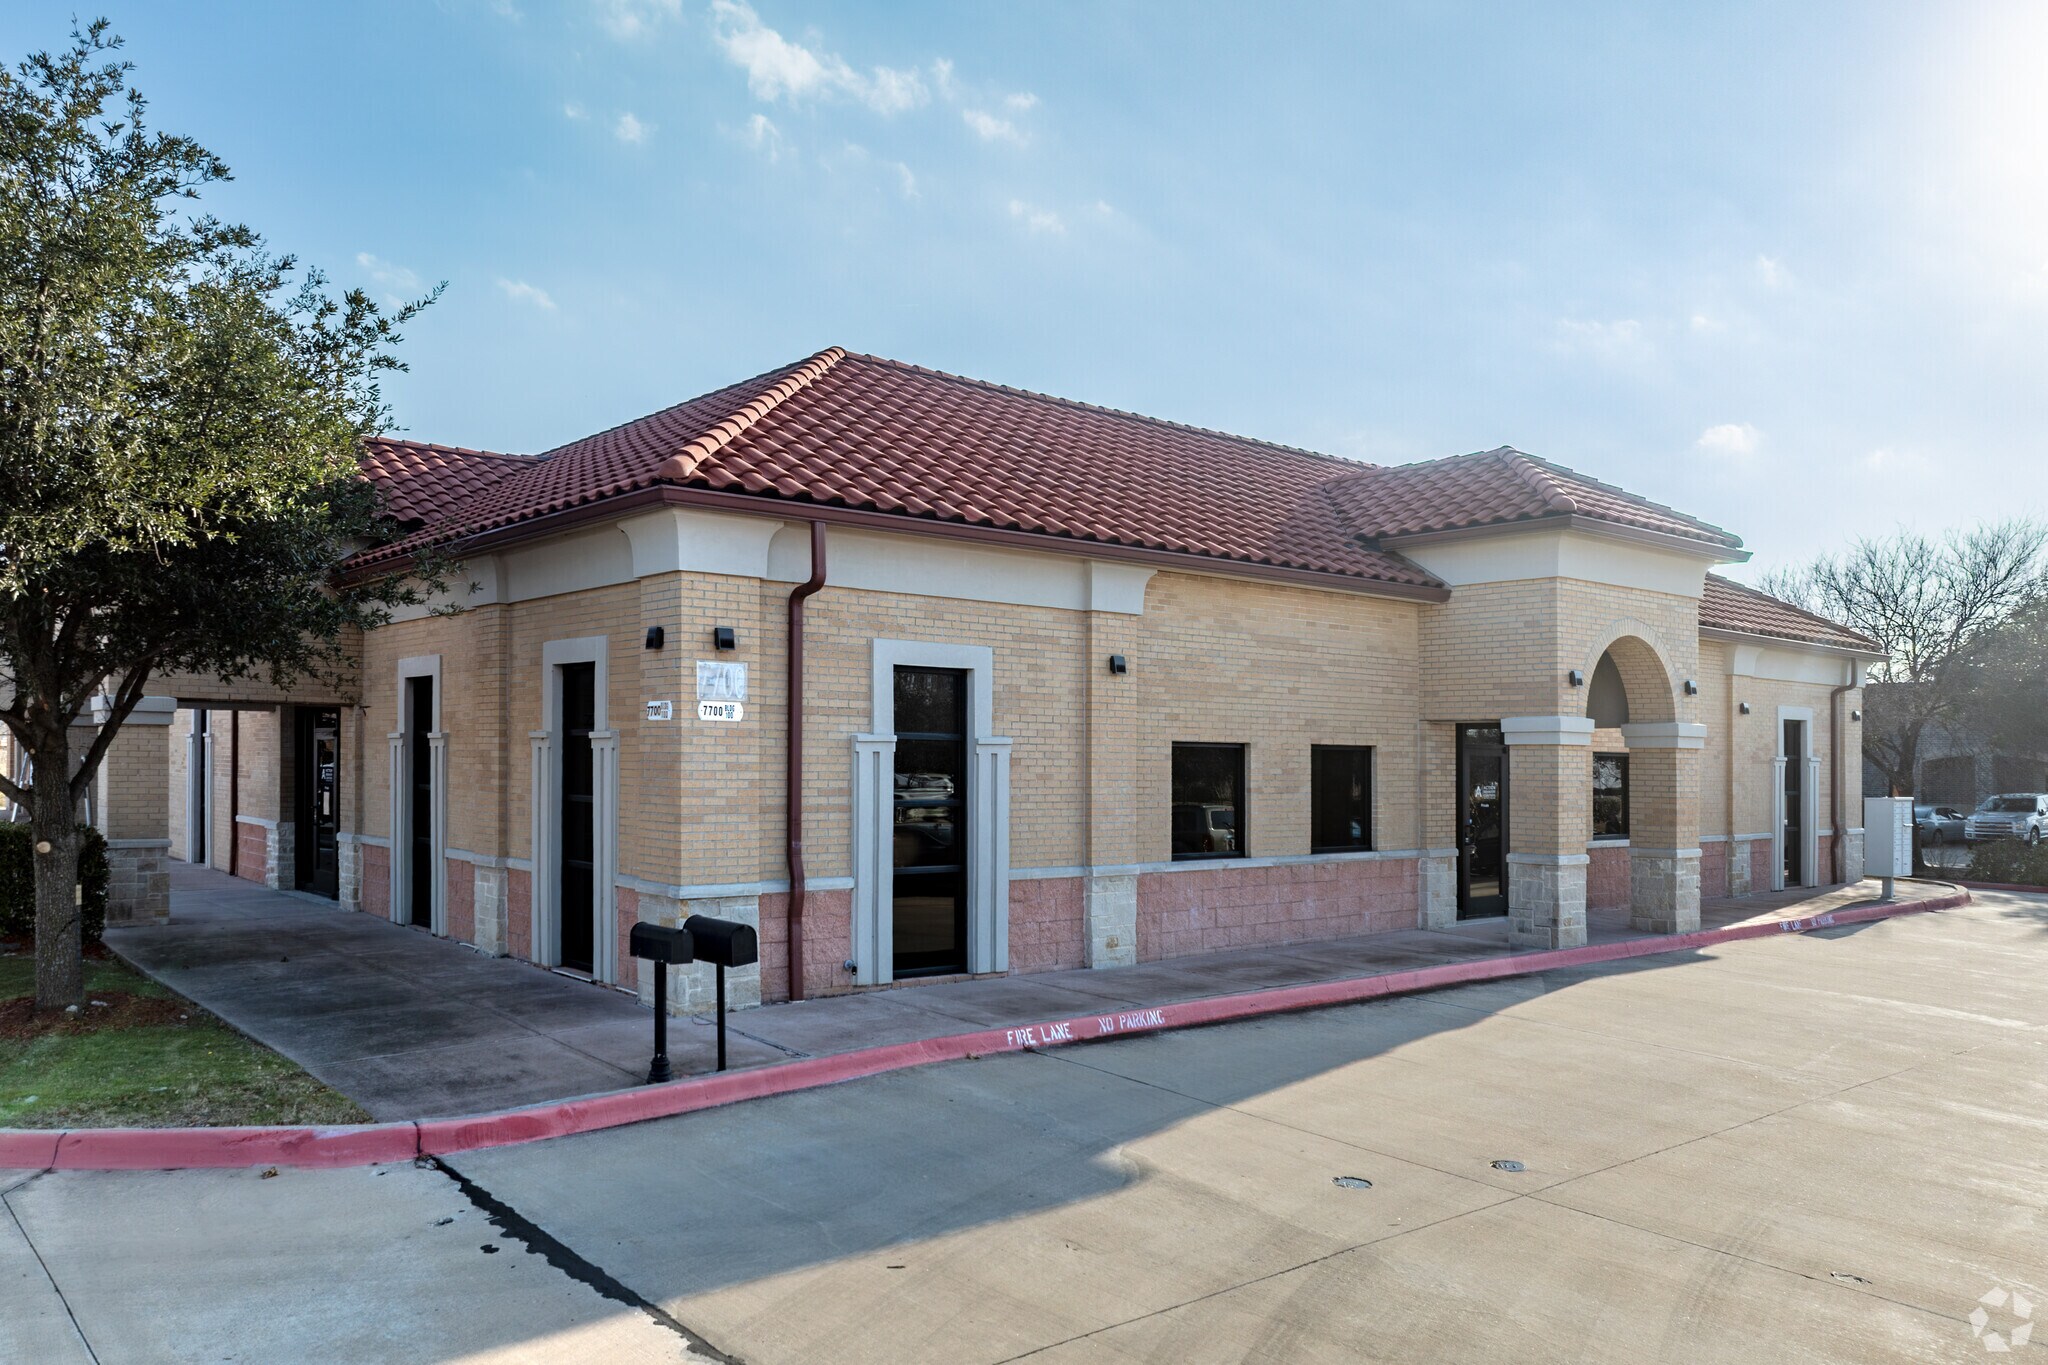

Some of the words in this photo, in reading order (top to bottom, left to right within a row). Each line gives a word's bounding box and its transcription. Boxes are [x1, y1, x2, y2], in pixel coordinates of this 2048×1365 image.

[647, 706, 661, 716] 7700
[703, 706, 723, 716] 7700
[1007, 1028, 1036, 1045] FIRE
[1041, 1023, 1073, 1042] LANE
[1098, 1017, 1114, 1032] NO
[1119, 1010, 1165, 1030] PARKING
